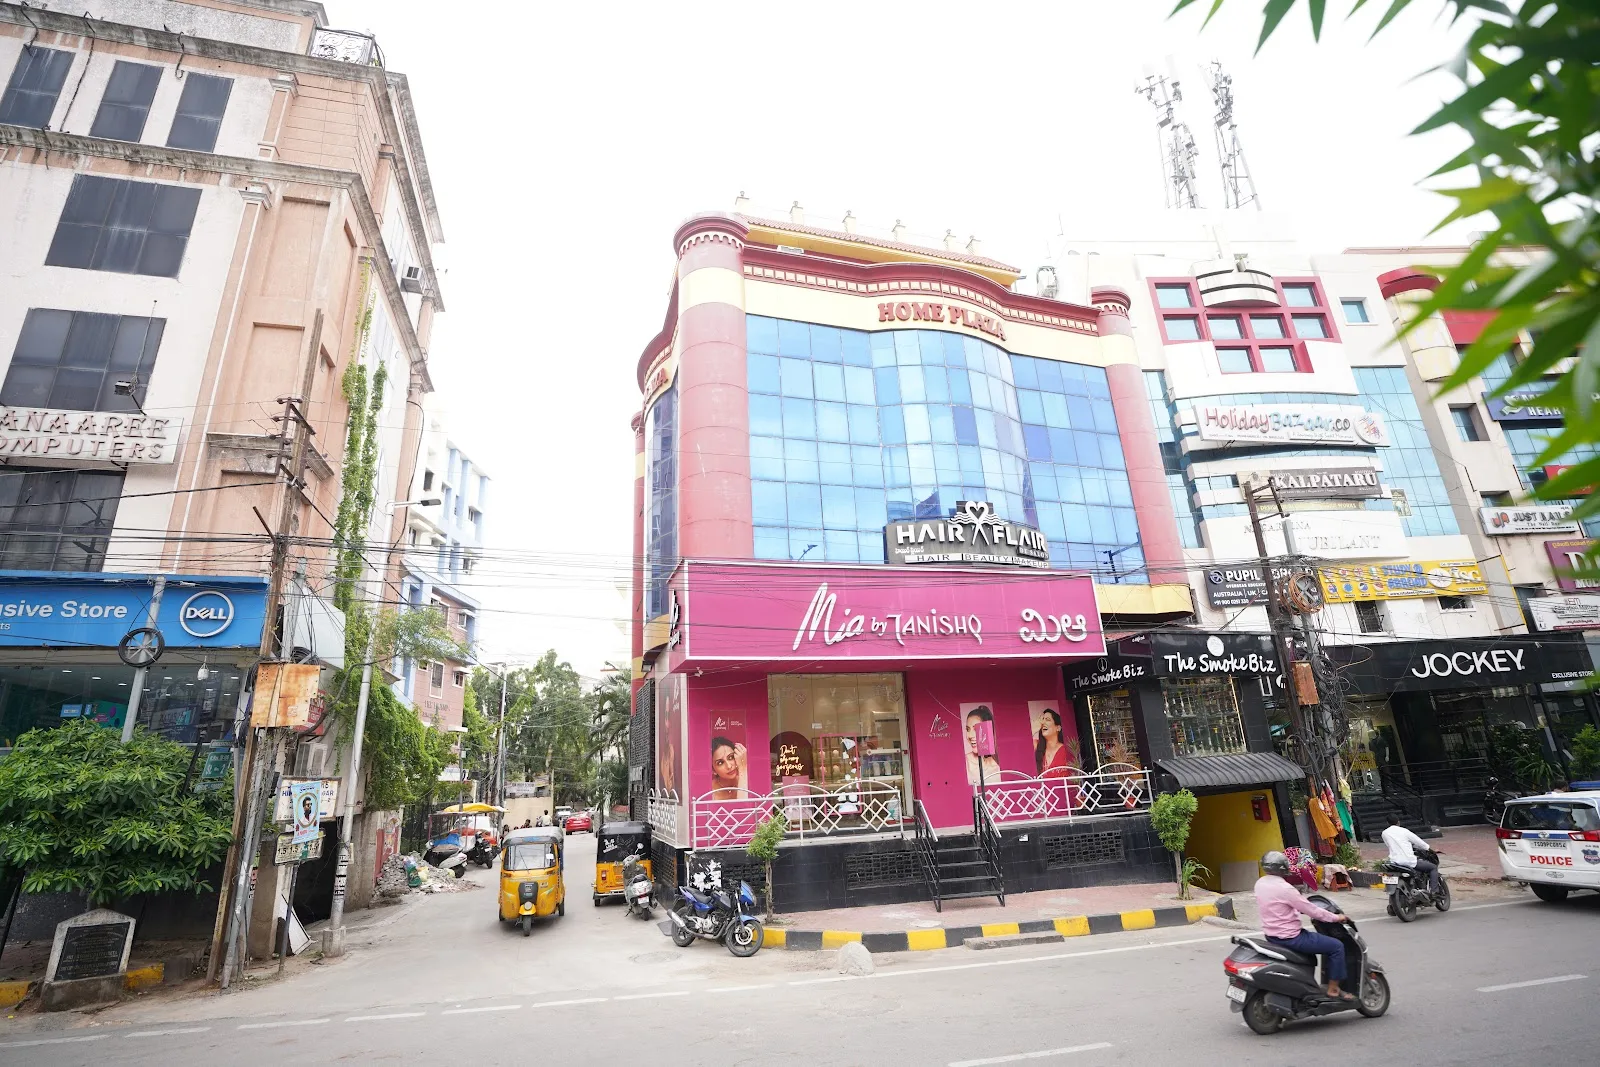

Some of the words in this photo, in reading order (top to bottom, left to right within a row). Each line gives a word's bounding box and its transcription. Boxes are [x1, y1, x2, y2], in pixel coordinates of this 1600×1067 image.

[877, 301, 944, 322] HOME
[949, 309, 1007, 341] PLAZA
[1275, 471, 1377, 489] KALPATARU
[1513, 512, 1537, 522] JUST
[896, 523, 966, 545] HAIR
[993, 524, 1047, 551] FLAIR
[916, 554, 950, 562] HAIR
[964, 553, 1009, 563] BEAUTY
[1013, 557, 1049, 568] MAKEUP
[1225, 569, 1261, 582] PUPIL
[0, 599, 54, 618] sive
[60, 600, 128, 618] Store
[185, 606, 227, 620] DELL
[792, 582, 865, 651] Mia
[870, 617, 887, 637] by
[1164, 652, 1197, 673] The
[1199, 653, 1248, 673] Smoke
[1248, 653, 1277, 673] Biz
[1411, 649, 1525, 678] JOCKEY
[1072, 674, 1090, 689] The
[1091, 669, 1123, 685] Smoke
[1124, 663, 1144, 679] Biz
[1578, 670, 1595, 678] STORE
[1529, 855, 1573, 866] POLICE
